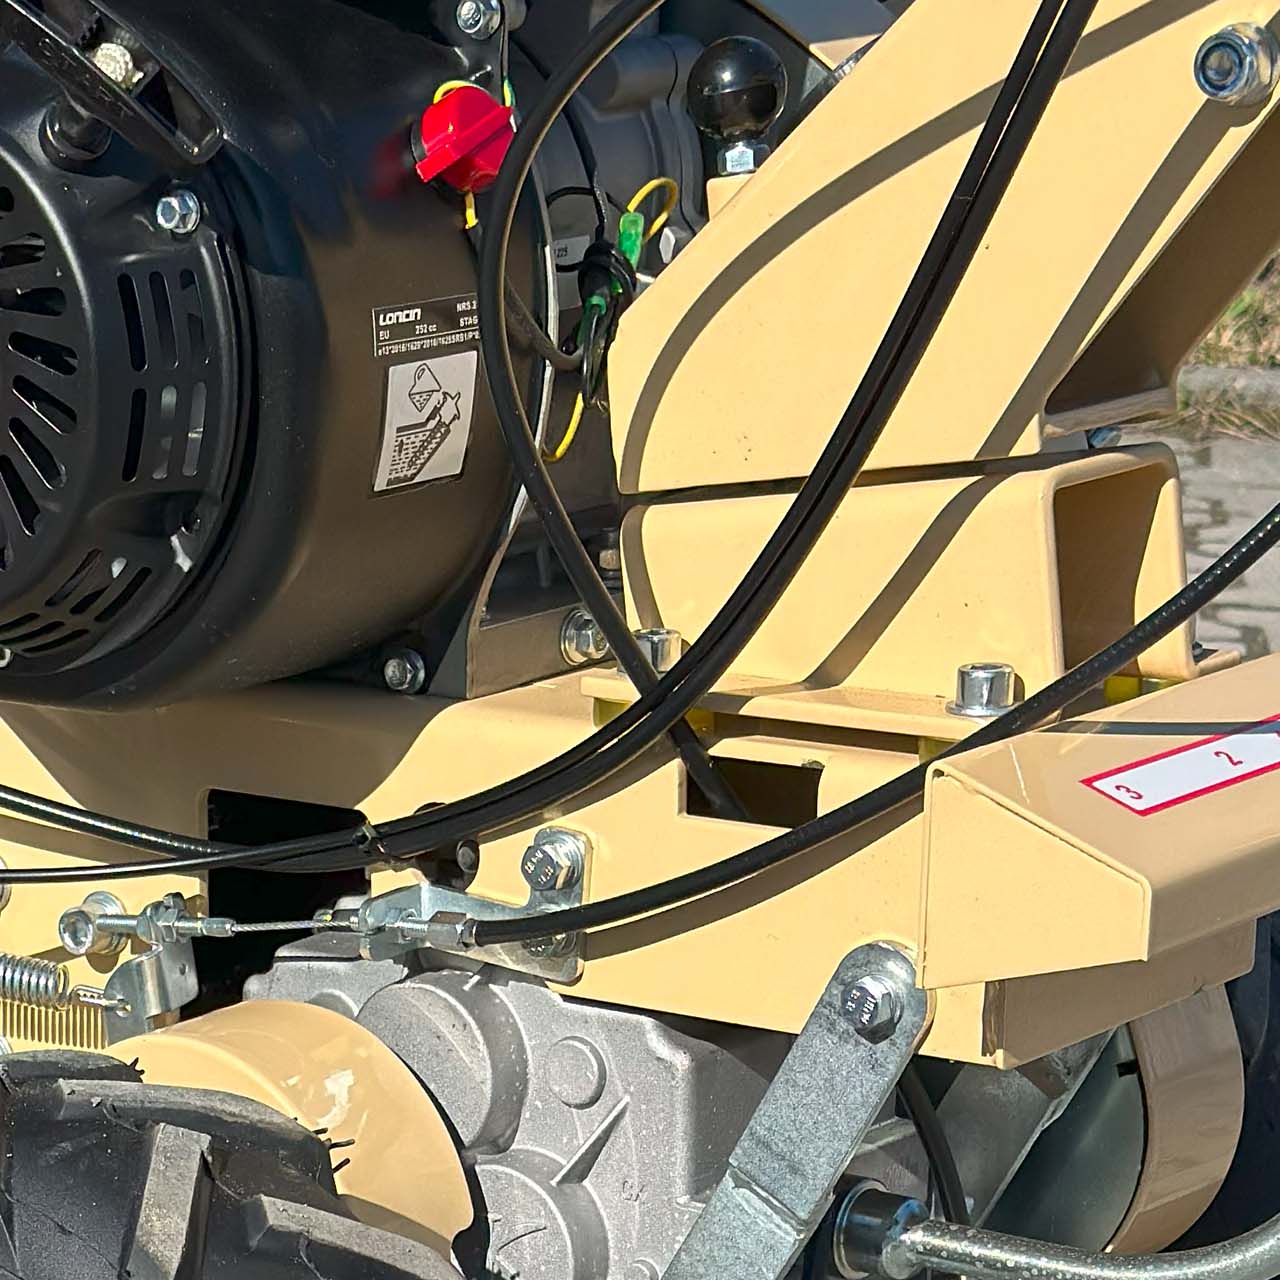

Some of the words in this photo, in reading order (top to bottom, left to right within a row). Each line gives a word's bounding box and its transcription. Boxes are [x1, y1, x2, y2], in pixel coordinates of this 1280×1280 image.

[379, 330, 389, 340] EU
[1213, 750, 1244, 766] 2
[1114, 784, 1144, 800] 3
